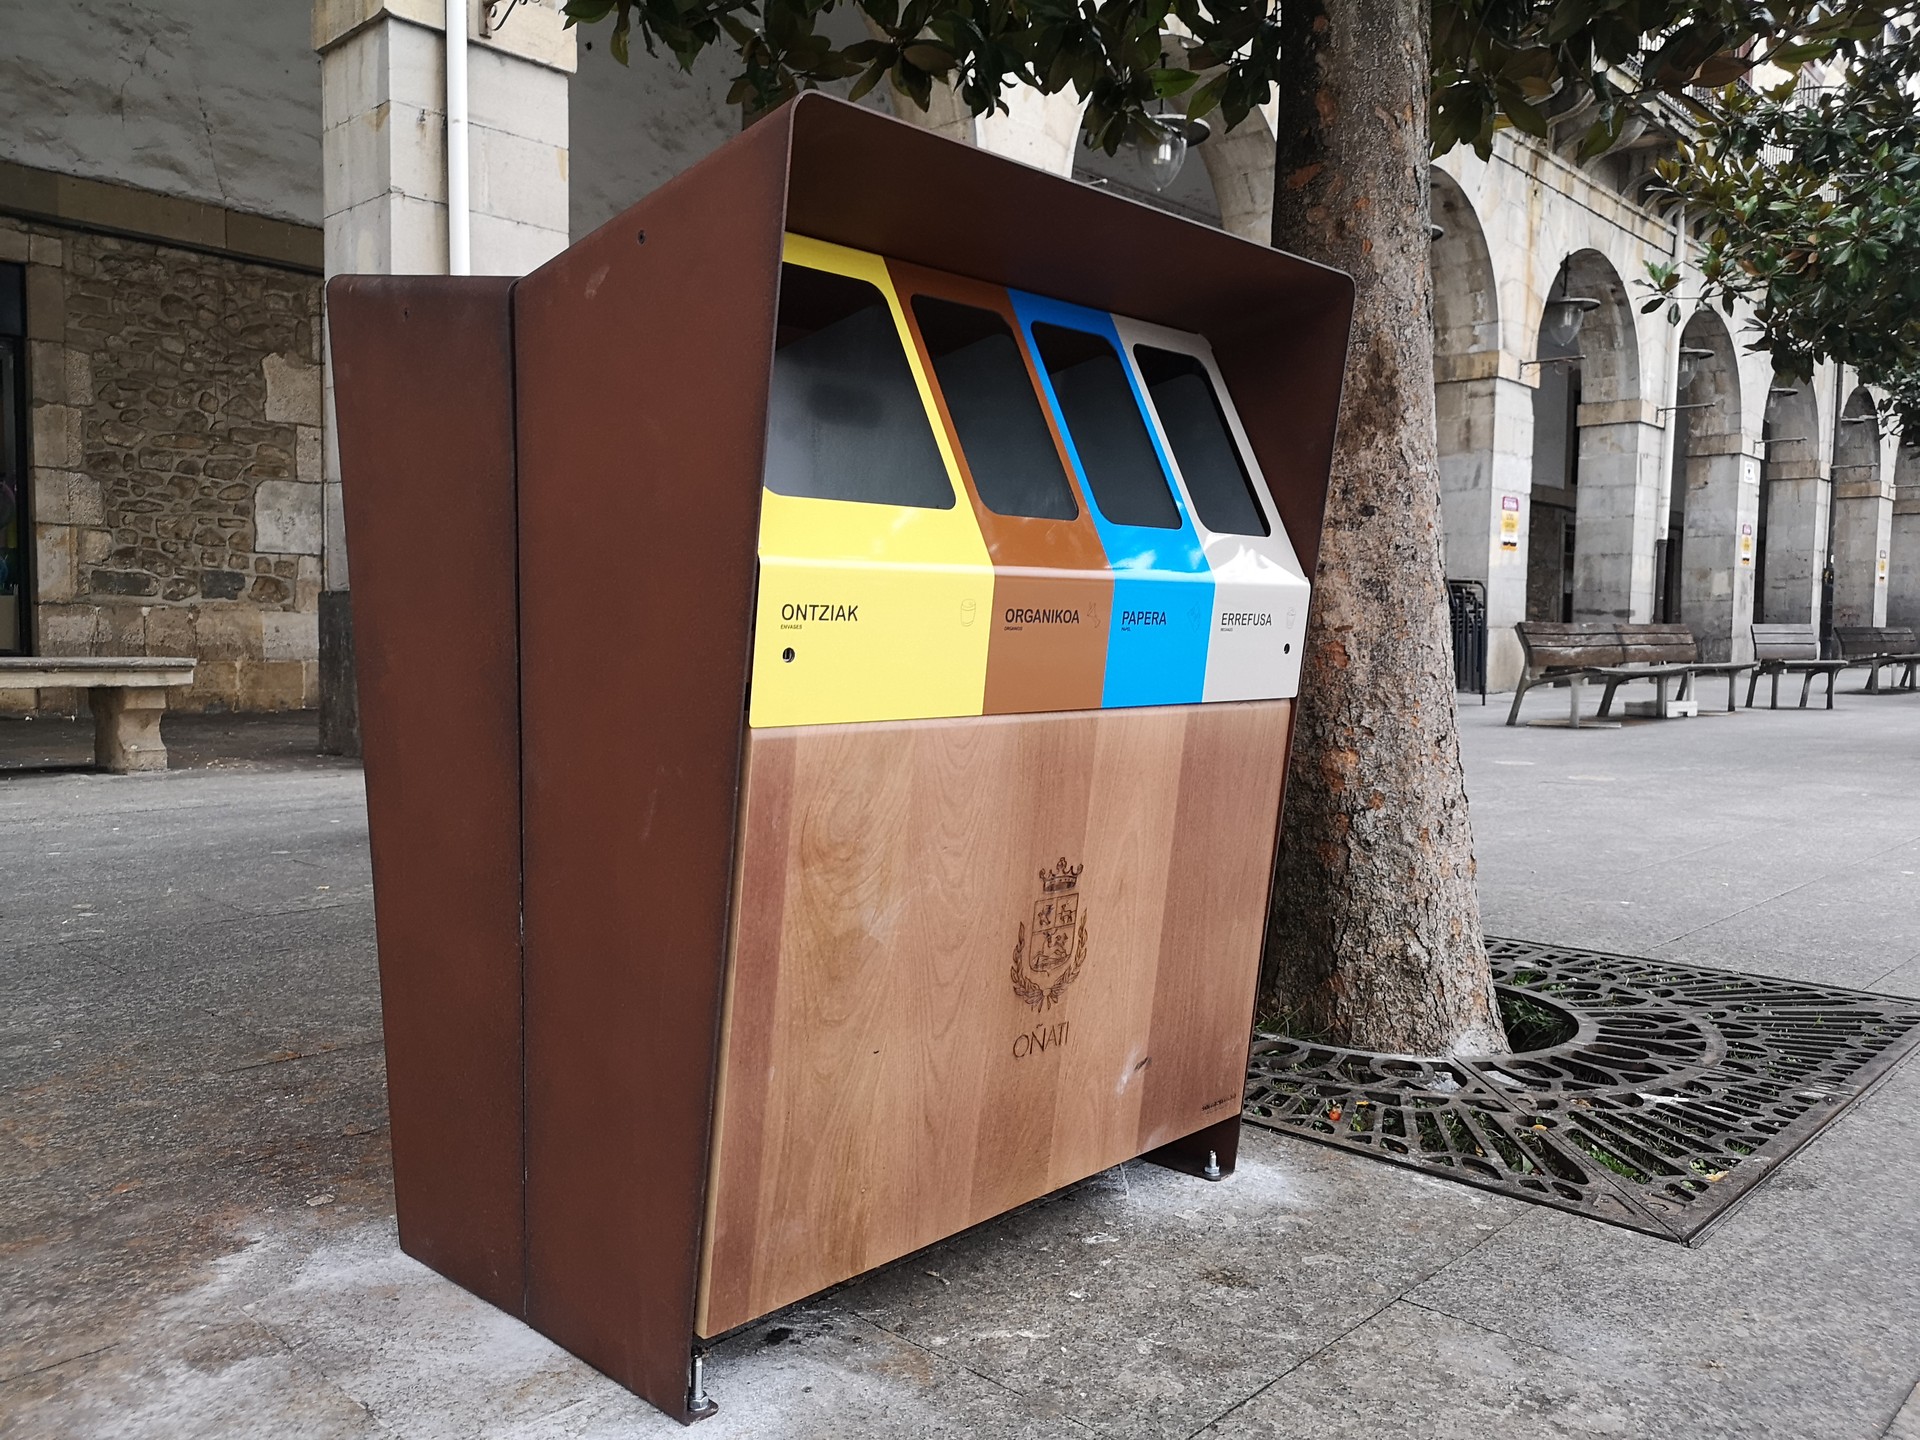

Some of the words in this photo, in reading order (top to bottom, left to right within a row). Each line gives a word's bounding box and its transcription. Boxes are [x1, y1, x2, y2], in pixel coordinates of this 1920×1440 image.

[781, 603, 859, 622] ONTZIAK
[1005, 608, 1080, 624] ORGANIKOA
[1121, 610, 1167, 626] PAPERA
[1221, 612, 1272, 626] ERREFUSA
[1012, 1021, 1070, 1058] OÑATI
